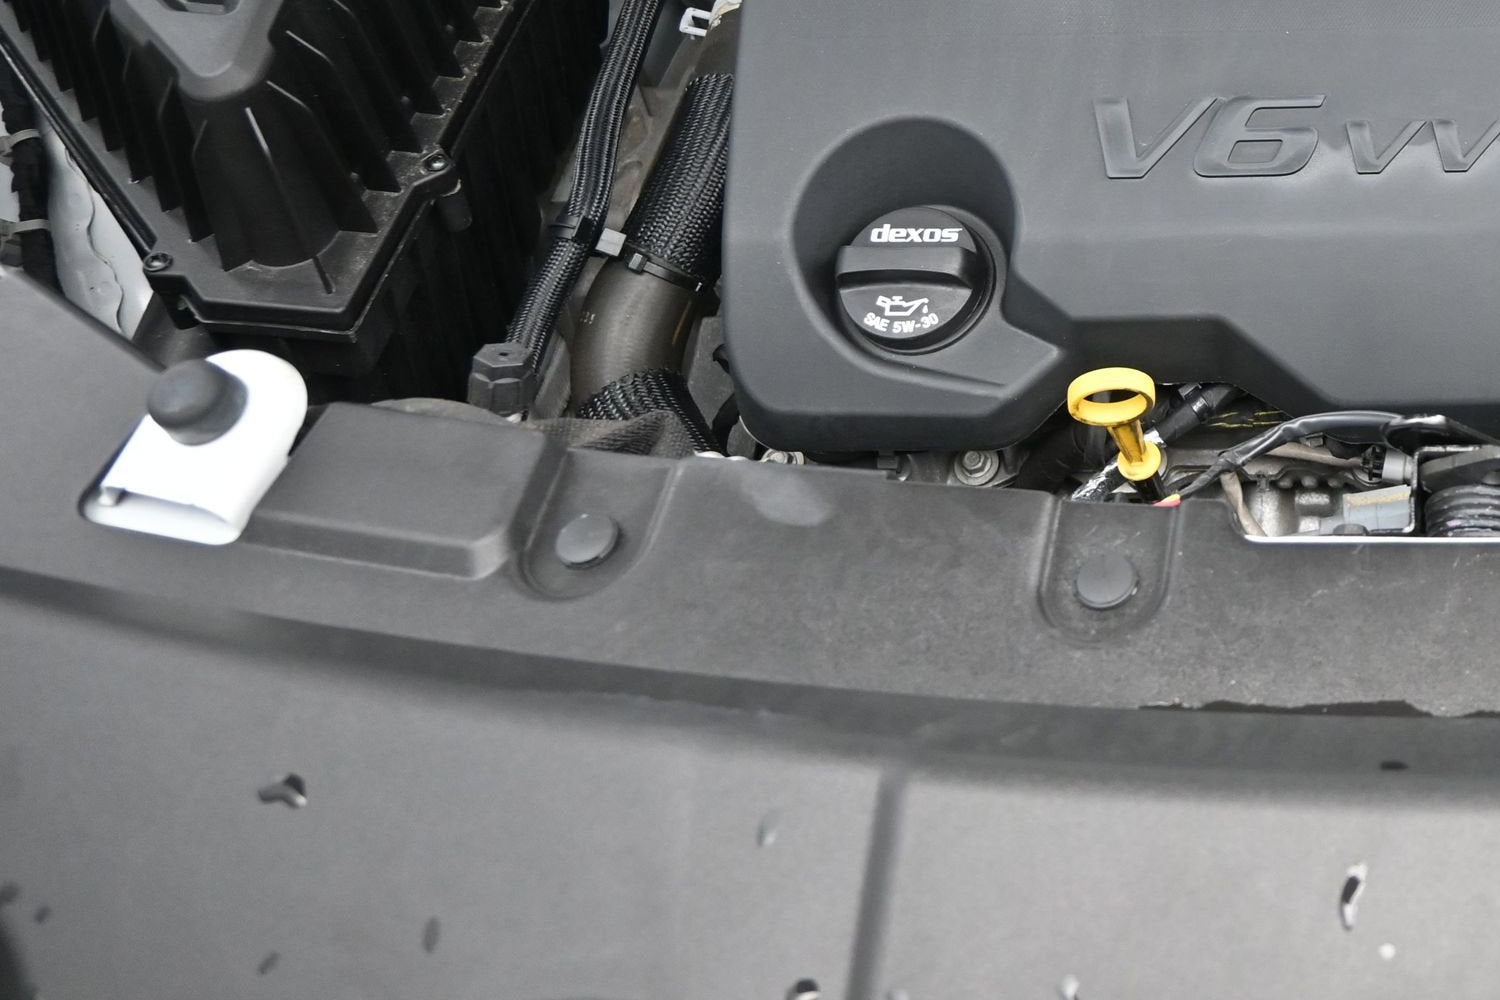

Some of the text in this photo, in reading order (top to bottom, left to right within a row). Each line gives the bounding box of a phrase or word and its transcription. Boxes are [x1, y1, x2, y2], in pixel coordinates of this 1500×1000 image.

[1094, 94, 1327, 178] V6
[870, 223, 963, 243] dexos
[863, 312, 939, 333] SAE 5W-30
